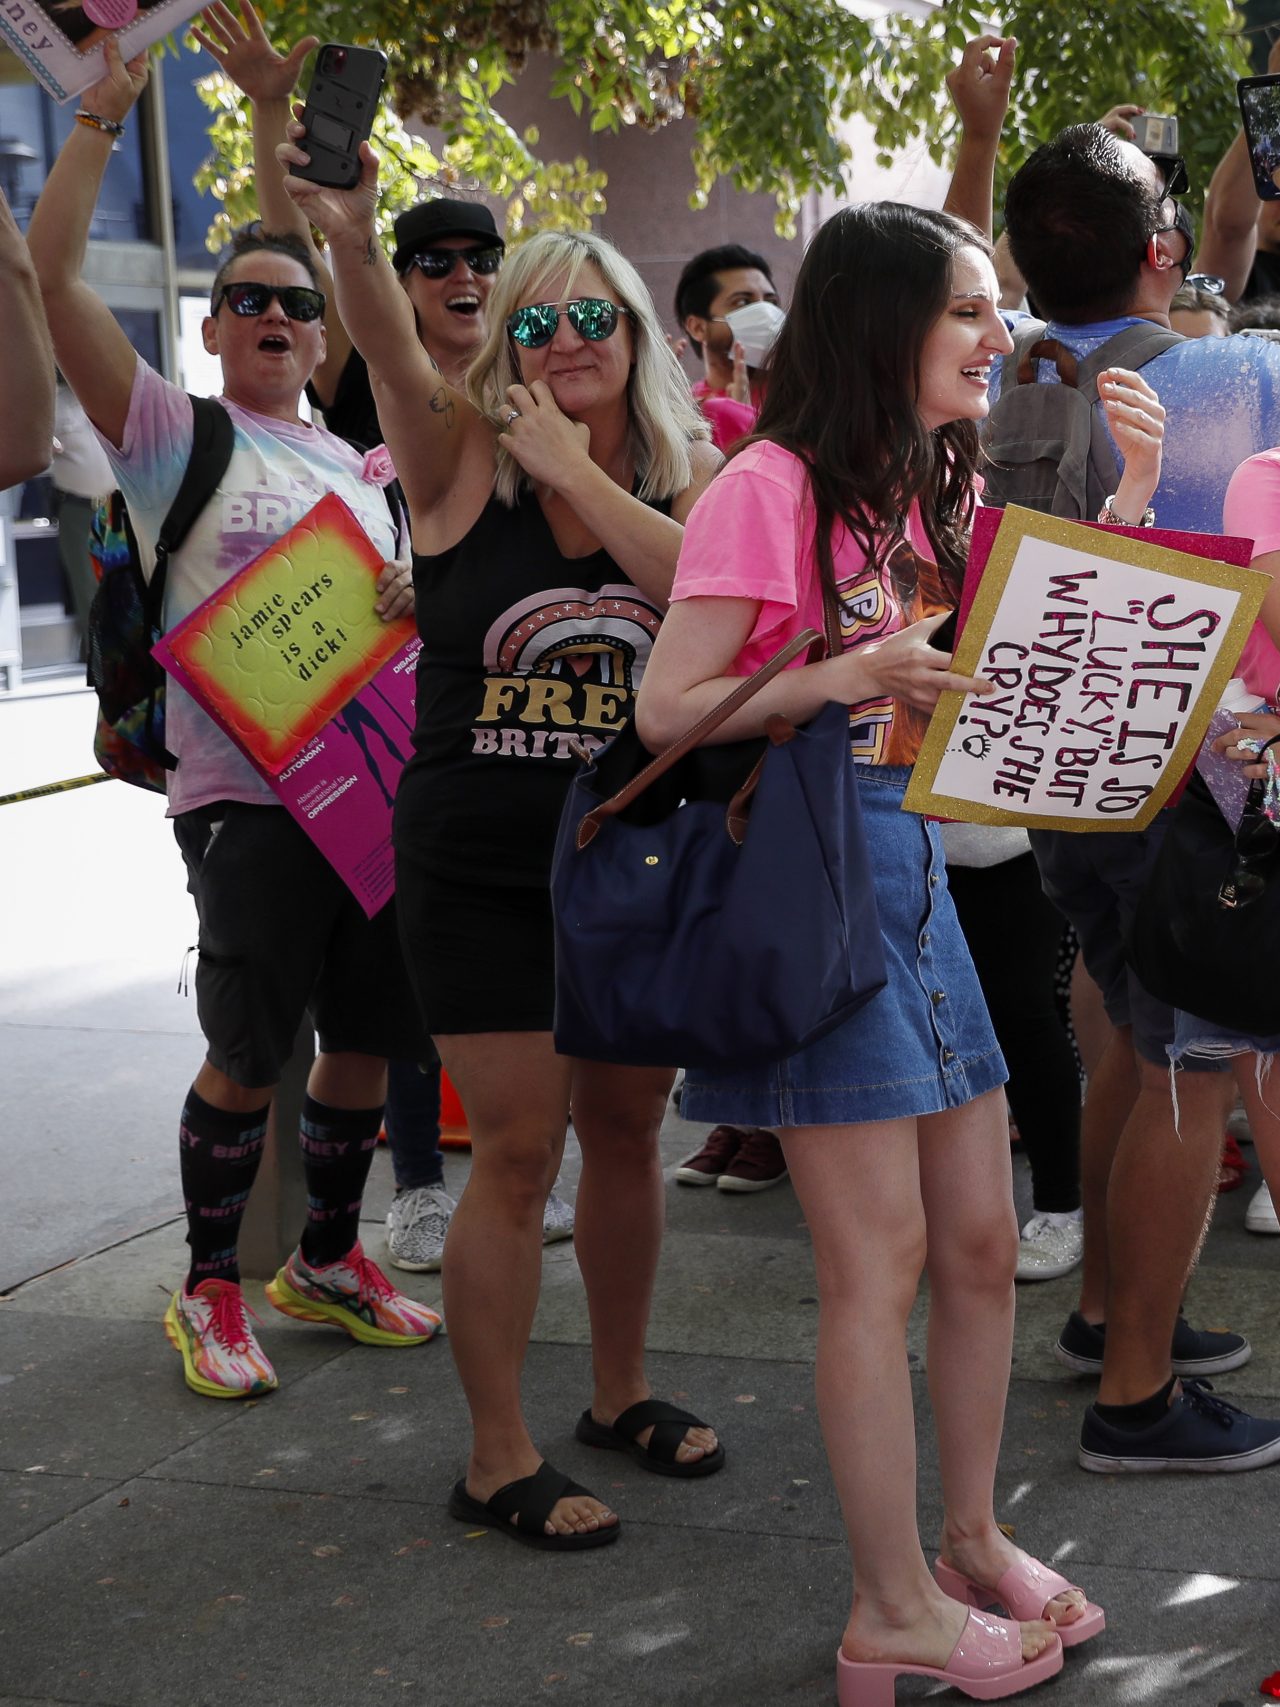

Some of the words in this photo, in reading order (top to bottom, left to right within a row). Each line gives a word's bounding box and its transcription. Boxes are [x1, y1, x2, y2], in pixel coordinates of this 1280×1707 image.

[0, 0, 53, 50] ney
[231, 594, 285, 649] jamie
[272, 573, 333, 639] spears
[1031, 570, 1098, 664] WHY
[281, 642, 301, 664] is
[312, 621, 326, 636] a
[298, 628, 347, 682] dick!
[393, 643, 424, 674] DISABL
[1126, 594, 1222, 713] SHE
[475, 677, 638, 731] FRE
[958, 641, 1031, 740] CRY?
[1013, 663, 1077, 737] DOES
[279, 741, 326, 782] AUTONOMY
[993, 735, 1045, 803] SHE
[1109, 720, 1179, 770] IS
[297, 784, 321, 805] Ableism
[302, 780, 338, 812] foundational
[337, 775, 345, 783] to
[307, 775, 358, 819] OPPRESSION
[1046, 746, 1100, 807] BUT
[1096, 777, 1155, 813] SO
